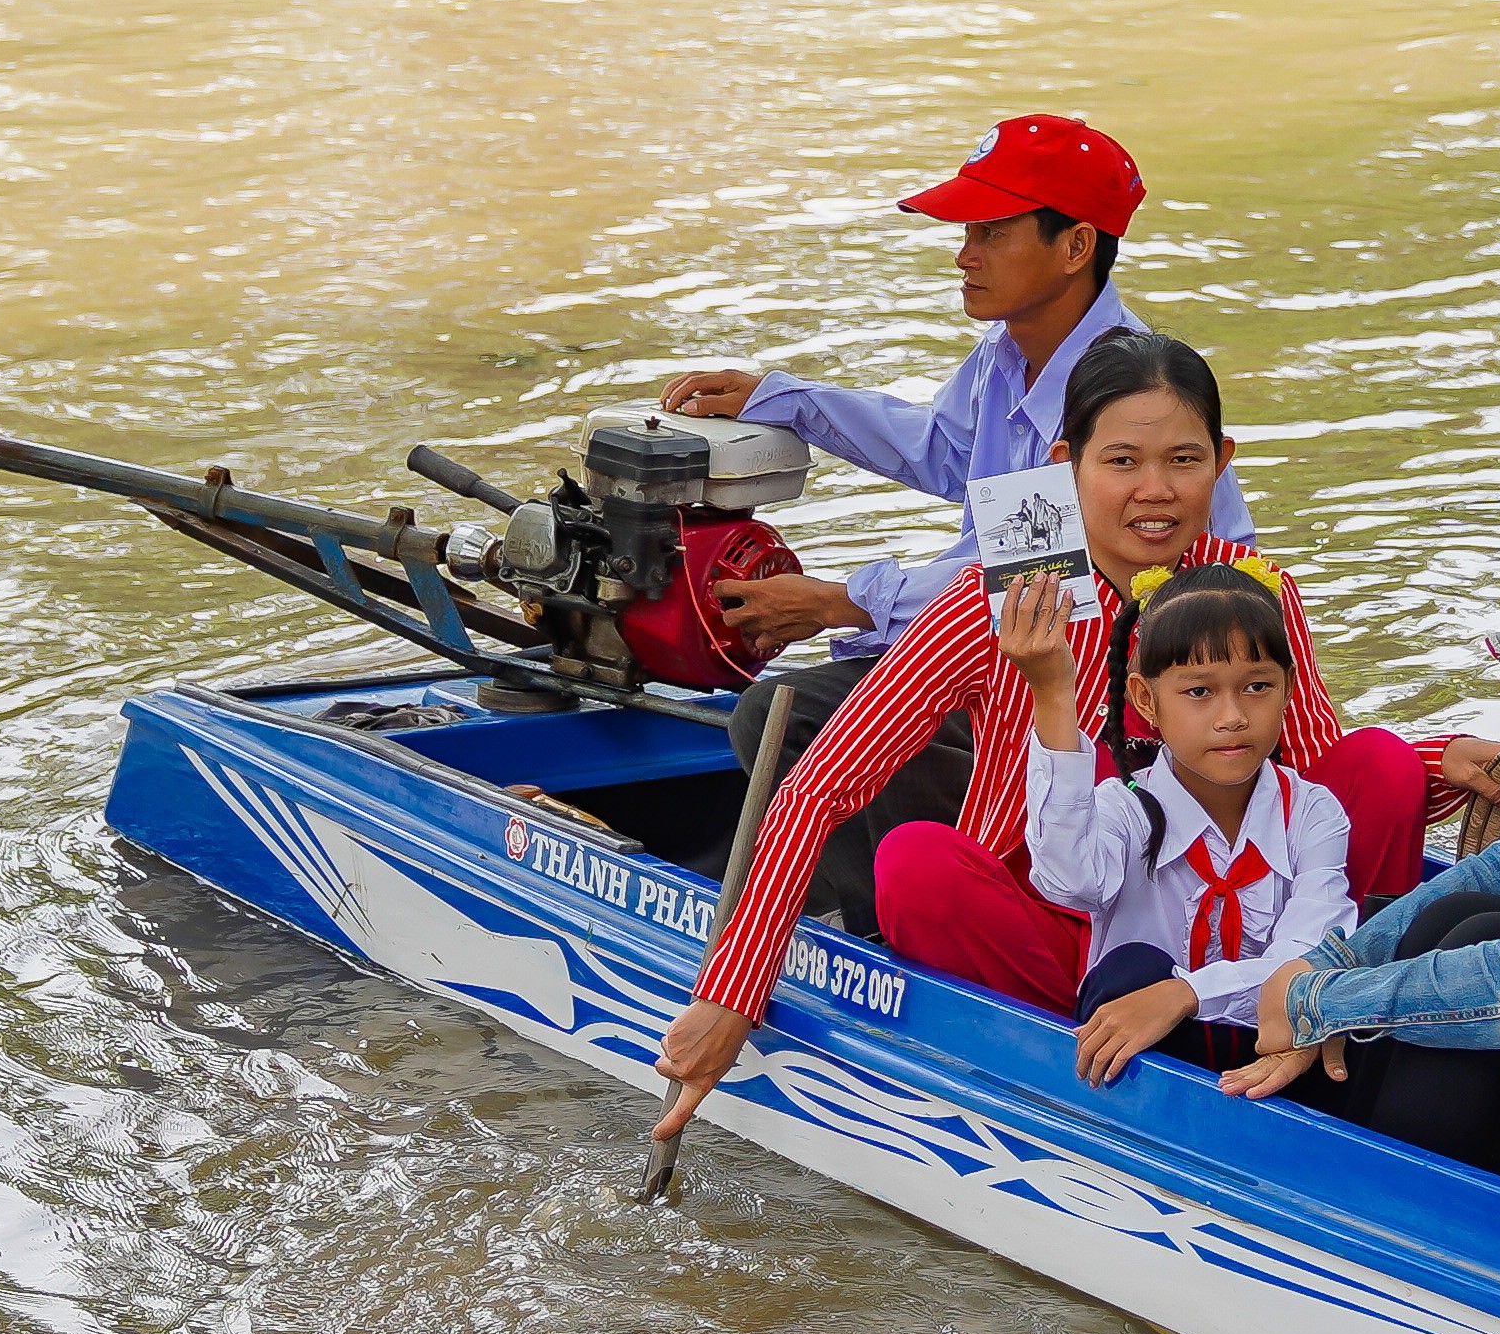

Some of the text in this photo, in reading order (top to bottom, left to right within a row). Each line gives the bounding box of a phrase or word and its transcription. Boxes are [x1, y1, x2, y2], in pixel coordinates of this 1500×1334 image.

[531, 831, 715, 943] THÀNH PHÁT
[785, 936, 906, 1018] 0918 372 007
